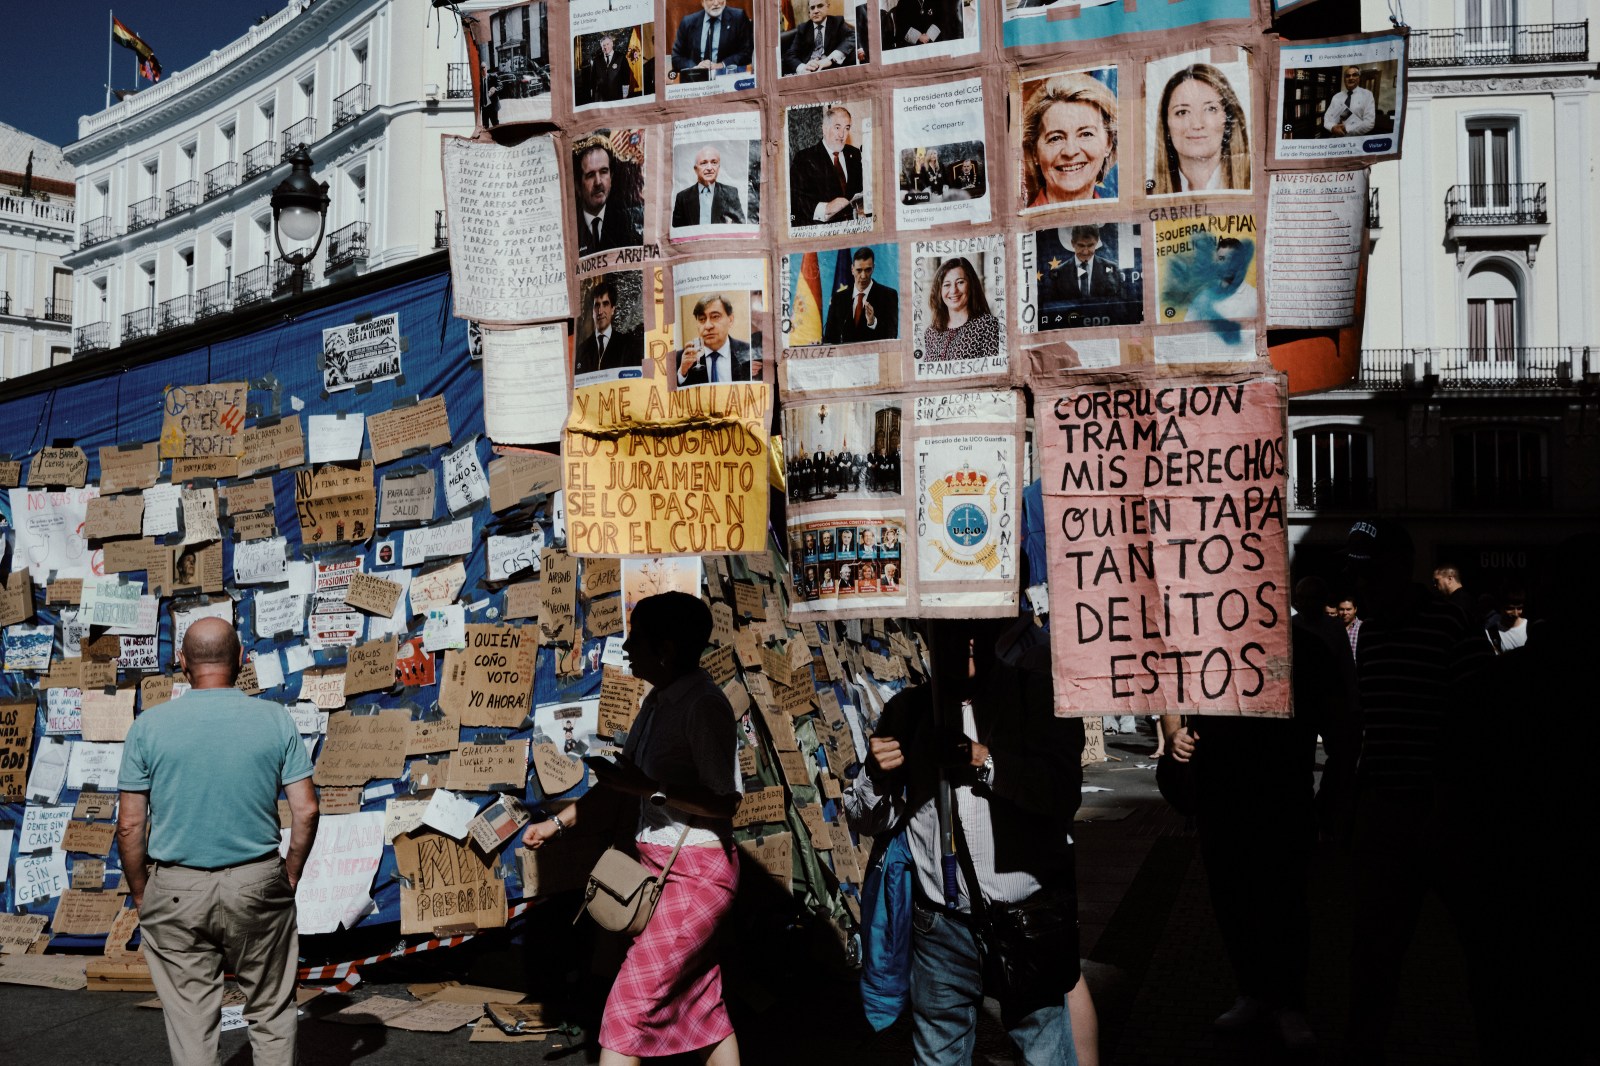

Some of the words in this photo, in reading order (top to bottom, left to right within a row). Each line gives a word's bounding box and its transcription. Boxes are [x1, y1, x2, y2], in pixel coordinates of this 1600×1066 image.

[903, 96, 912, 104] La
[913, 91, 952, 104] presidenta
[954, 89, 965, 97] del
[904, 103, 936, 112] defiende
[955, 97, 983, 107] firmeza
[931, 120, 965, 131] Compartir
[1149, 203, 1213, 221] GABRIEL
[575, 253, 608, 275] ANDRES
[710, 273, 732, 281] Melgar
[349, 334, 359, 344] SEA
[185, 387, 243, 410] PEOPLE
[577, 393, 589, 424] Y
[598, 386, 631, 425] ME
[645, 384, 766, 421] ANULAN
[1054, 385, 1244, 420] CORRUCION
[181, 410, 220, 433] OVER
[917, 409, 934, 420] SIN
[285, 425, 294, 433] NO
[1059, 415, 1188, 454] TRAMA
[184, 435, 235, 456] PROFIT
[629, 421, 762, 457] ABOGADOS
[448, 444, 470, 464] TECHO
[1144, 436, 1289, 488] DERECHOS
[449, 462, 477, 487] MENOS
[568, 462, 595, 491] EL
[605, 458, 754, 493] JURAMENTO
[296, 470, 312, 499] NO
[322, 480, 339, 488] FINAL
[27, 493, 46, 511] NO
[387, 490, 403, 499] PARA
[297, 502, 317, 529] ES
[326, 511, 340, 519] FINAL
[392, 506, 419, 516] SALUD
[650, 493, 745, 525] PASAN
[1192, 486, 1284, 531] TAPA
[409, 530, 424, 545] NO
[431, 527, 447, 540] HAY
[572, 521, 619, 554] POR
[629, 521, 662, 554] EL
[670, 521, 745, 552] CULO
[503, 550, 541, 574] CASA
[543, 555, 554, 572] TU
[1480, 551, 1527, 569] GOIKO
[474, 629, 521, 648] QUIÉN
[474, 653, 507, 667] COÑO
[487, 671, 519, 684] VOTO
[1110, 641, 1266, 703] ESTOS
[319, 681, 341, 691] GENTE
[468, 690, 484, 707] YO
[462, 746, 499, 757] GRACIAS
[7, 785, 22, 795] SER
[26, 812, 35, 820] ES
[26, 823, 48, 831] GENTE
[51, 821, 64, 829] SIN
[29, 832, 61, 846] CASAS
[24, 856, 53, 868] CASAS
[26, 867, 50, 883] SIN
[19, 876, 60, 901] GENTE
[417, 880, 500, 921] PASARÁN
